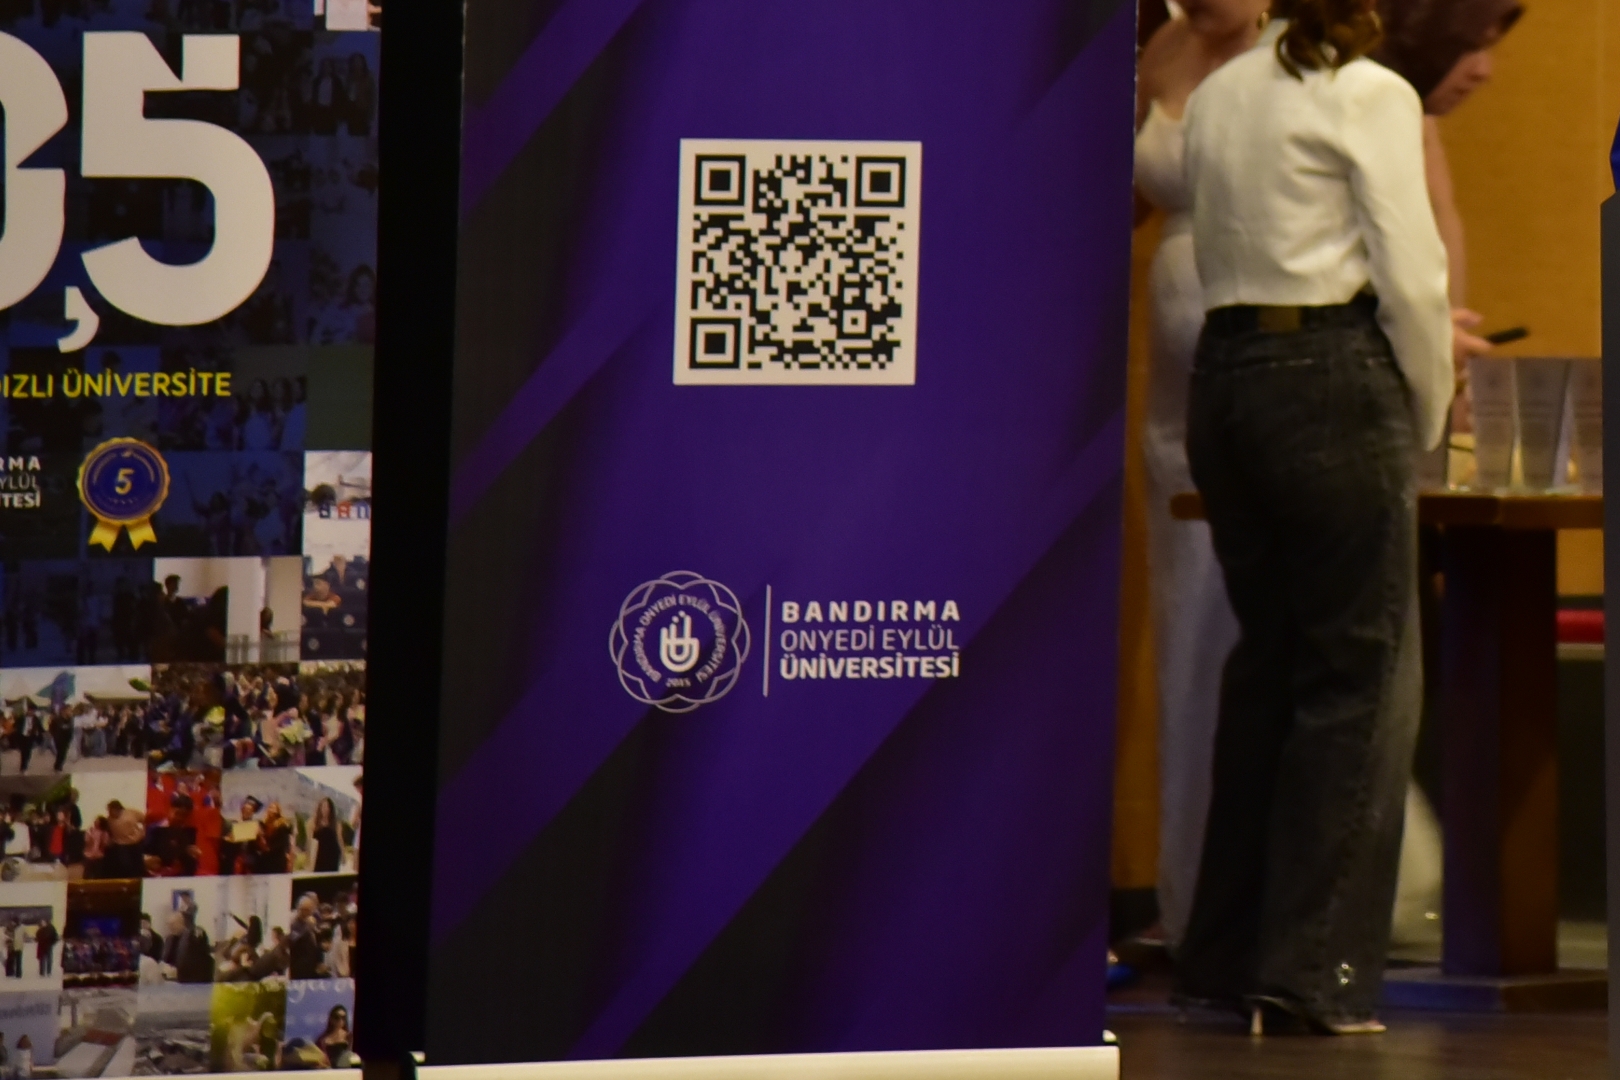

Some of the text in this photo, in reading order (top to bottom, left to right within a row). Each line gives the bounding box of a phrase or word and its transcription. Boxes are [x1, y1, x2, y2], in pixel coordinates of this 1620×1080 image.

[0, 368, 231, 398] IZLI ÜNİVERSİTE
[115, 468, 134, 495] 5
[782, 600, 960, 623] BANDIRMA
[781, 624, 959, 651] ONYEDİ EYLÜL
[781, 652, 960, 680] ÜNİVERSİTESİ
